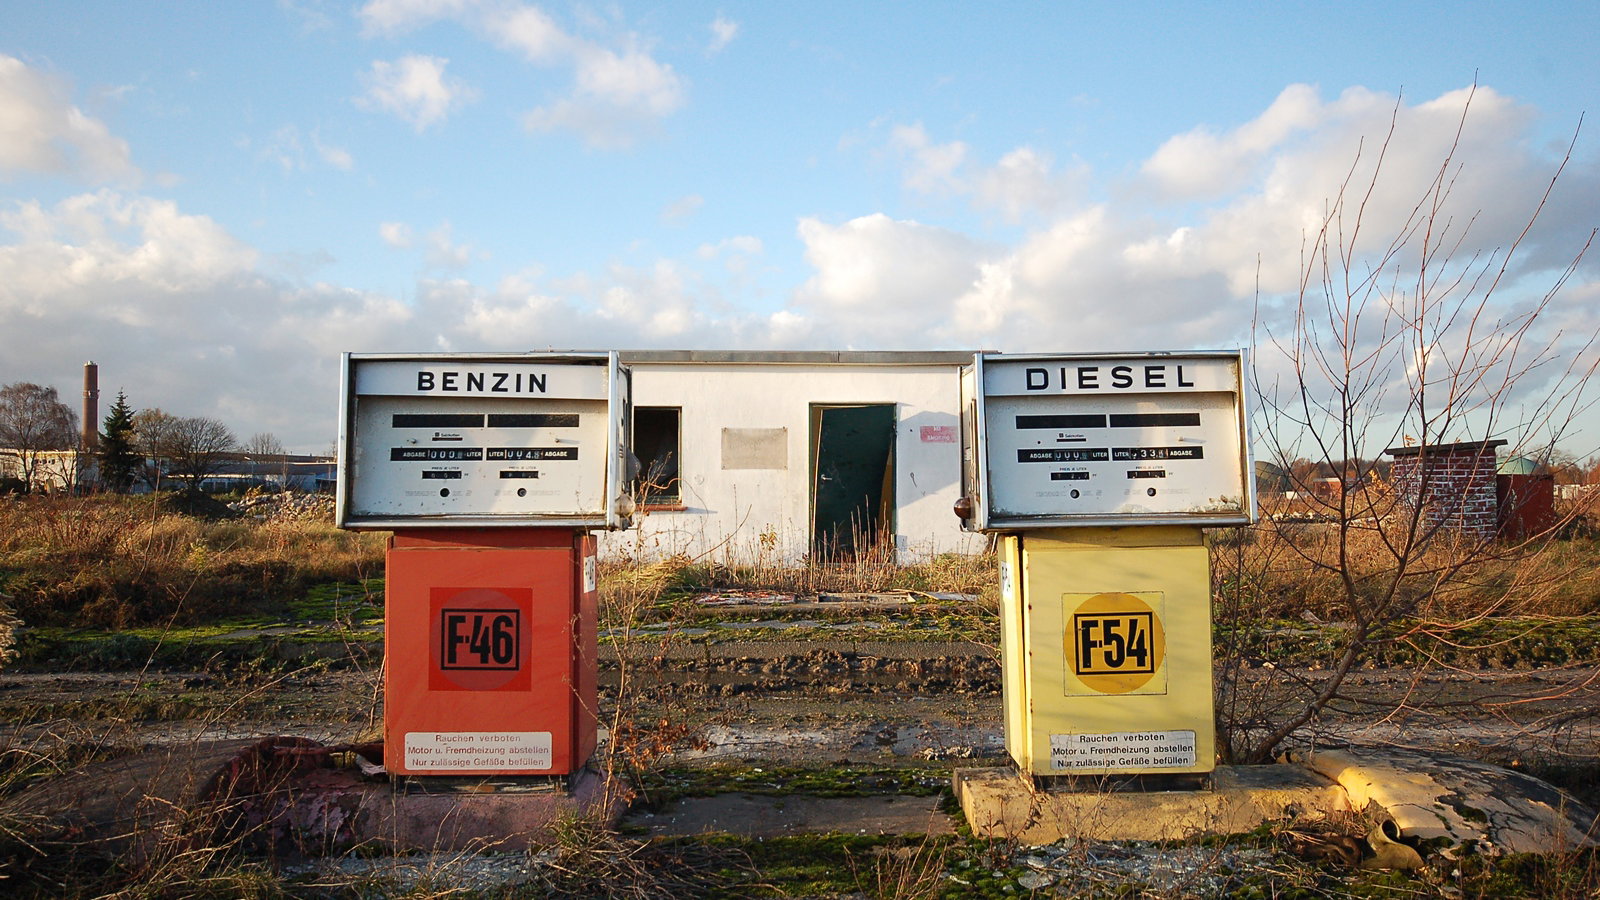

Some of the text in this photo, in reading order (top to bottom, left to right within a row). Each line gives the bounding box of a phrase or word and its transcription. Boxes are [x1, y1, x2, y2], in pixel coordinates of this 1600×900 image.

[417, 371, 547, 393] BENZIN
[1026, 365, 1194, 390] DIESEL
[448, 615, 513, 664] F-46
[479, 734, 521, 742] verboten
[1079, 734, 1165, 743] Rauchen verboten
[445, 746, 505, 756] Fremdheizung
[509, 746, 549, 754] abstellen
[1052, 748, 1077, 756] Motor
[1090, 746, 1150, 755] Fremdheizung
[1153, 745, 1193, 753] abstellen
[412, 757, 544, 767] Nur zulässige Gefäße befüllen
[1075, 758, 1116, 768] zulässige
[1118, 756, 1150, 766] Gefäße
[1153, 756, 1188, 765] befüllen
